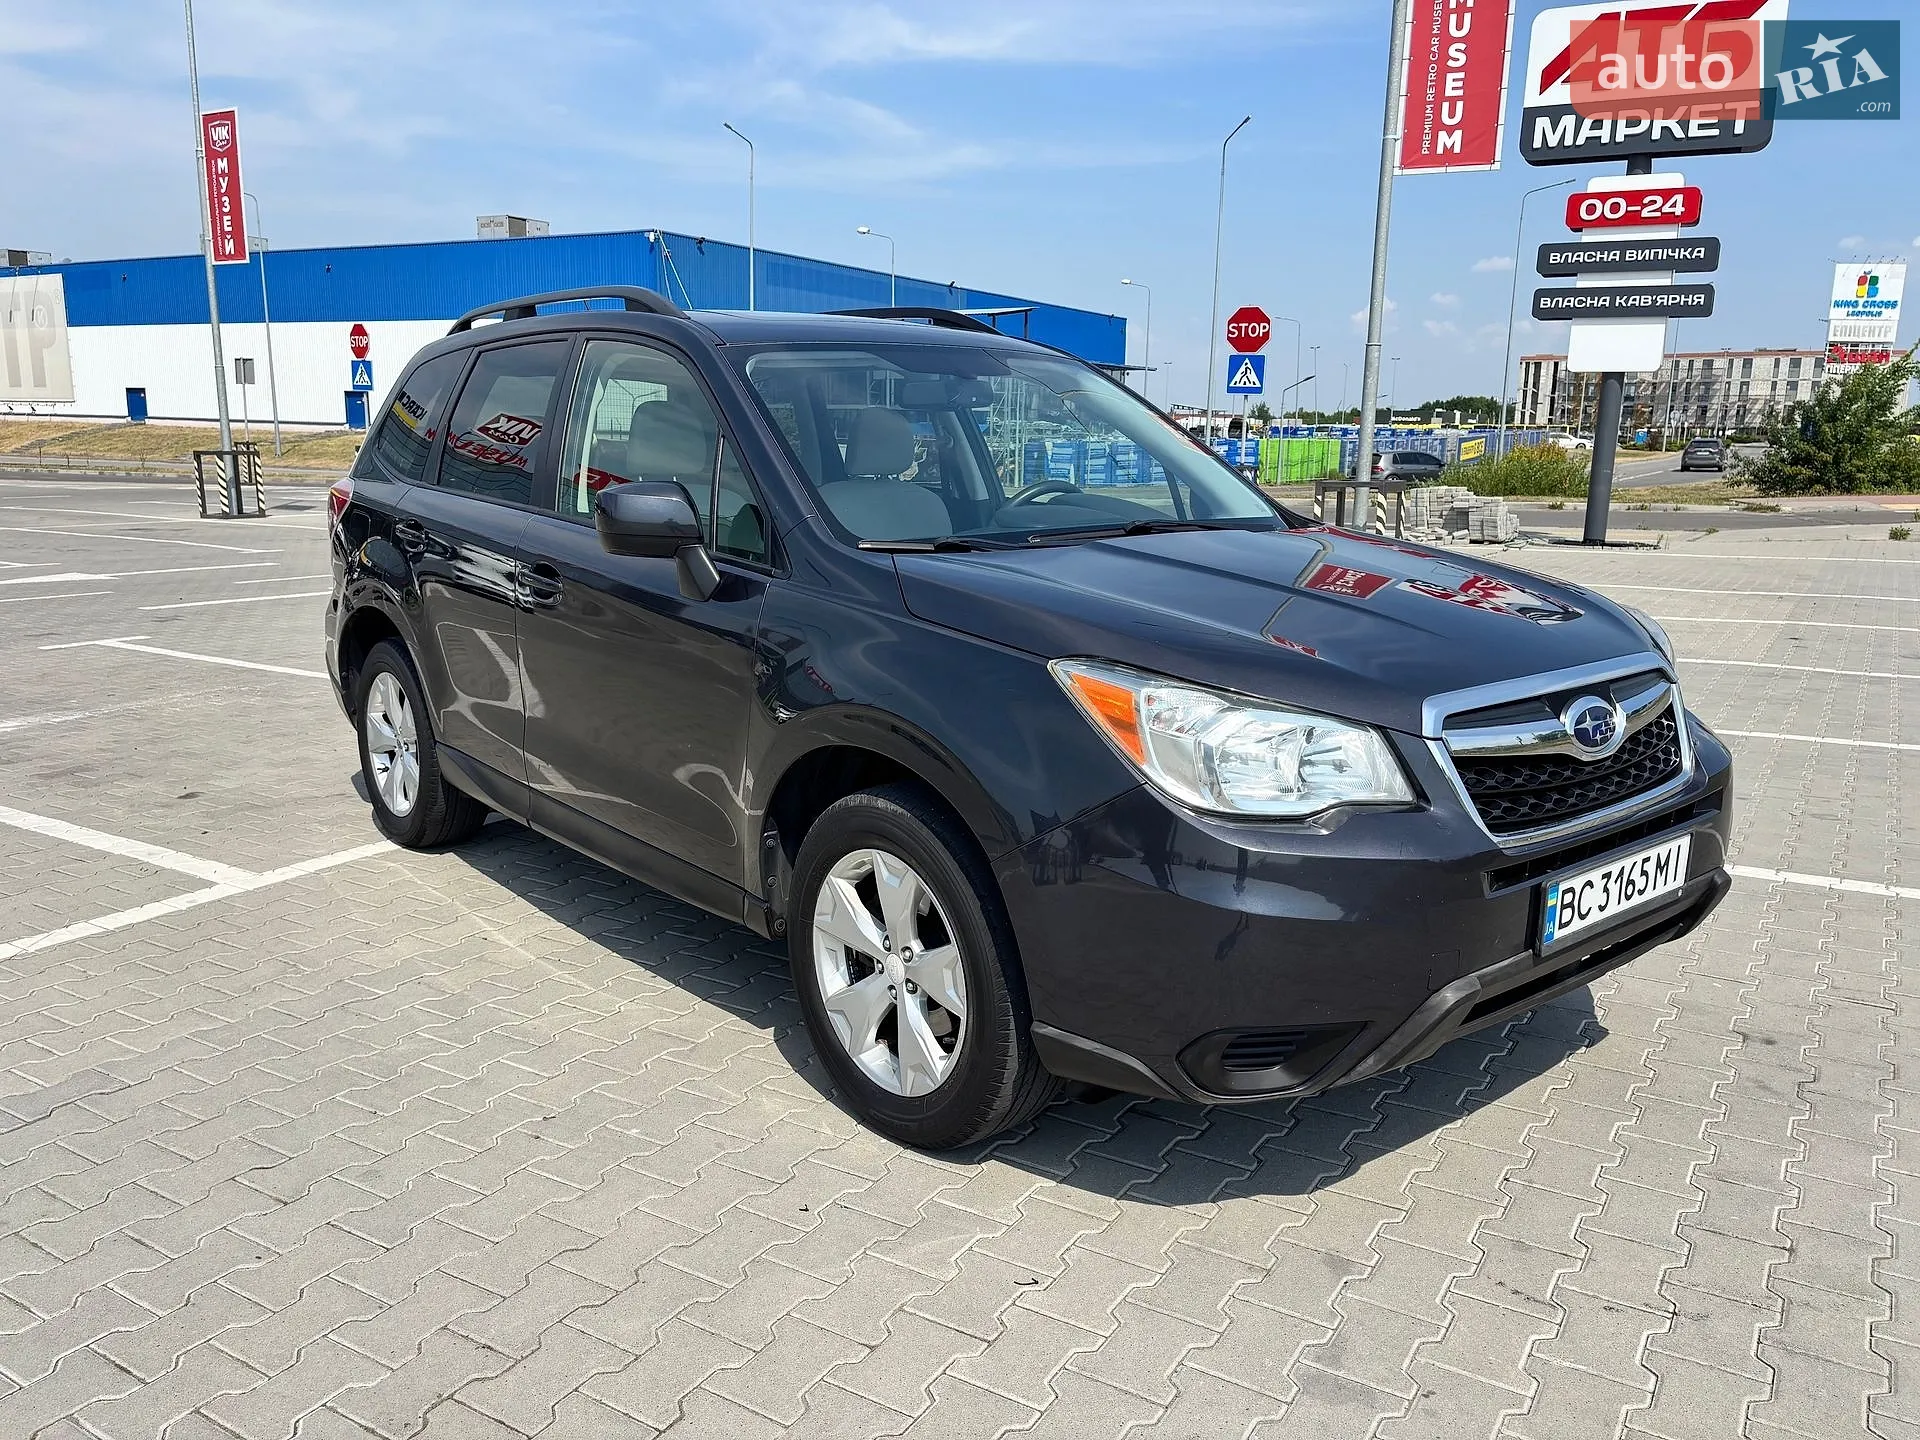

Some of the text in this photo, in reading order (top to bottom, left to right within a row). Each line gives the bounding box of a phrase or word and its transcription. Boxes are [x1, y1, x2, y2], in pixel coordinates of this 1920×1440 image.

[1429, 36, 1440, 61] CAR
[1426, 63, 1438, 101] RETRO
[210, 125, 230, 141] VIK
[1421, 104, 1435, 155] PREMIUM
[1532, 99, 1761, 149] МАРКЕТ
[217, 157, 235, 256] МУЗЕЙ
[1579, 193, 1686, 221] 00-24
[1549, 247, 1705, 265] ВЛАСНА ВИПІЧКА
[1539, 296, 1611, 309] ВЛАСНА
[1833, 299, 1898, 310] KING CROSS
[1228, 322, 1270, 338] STOP
[350, 335, 368, 348] STOP
